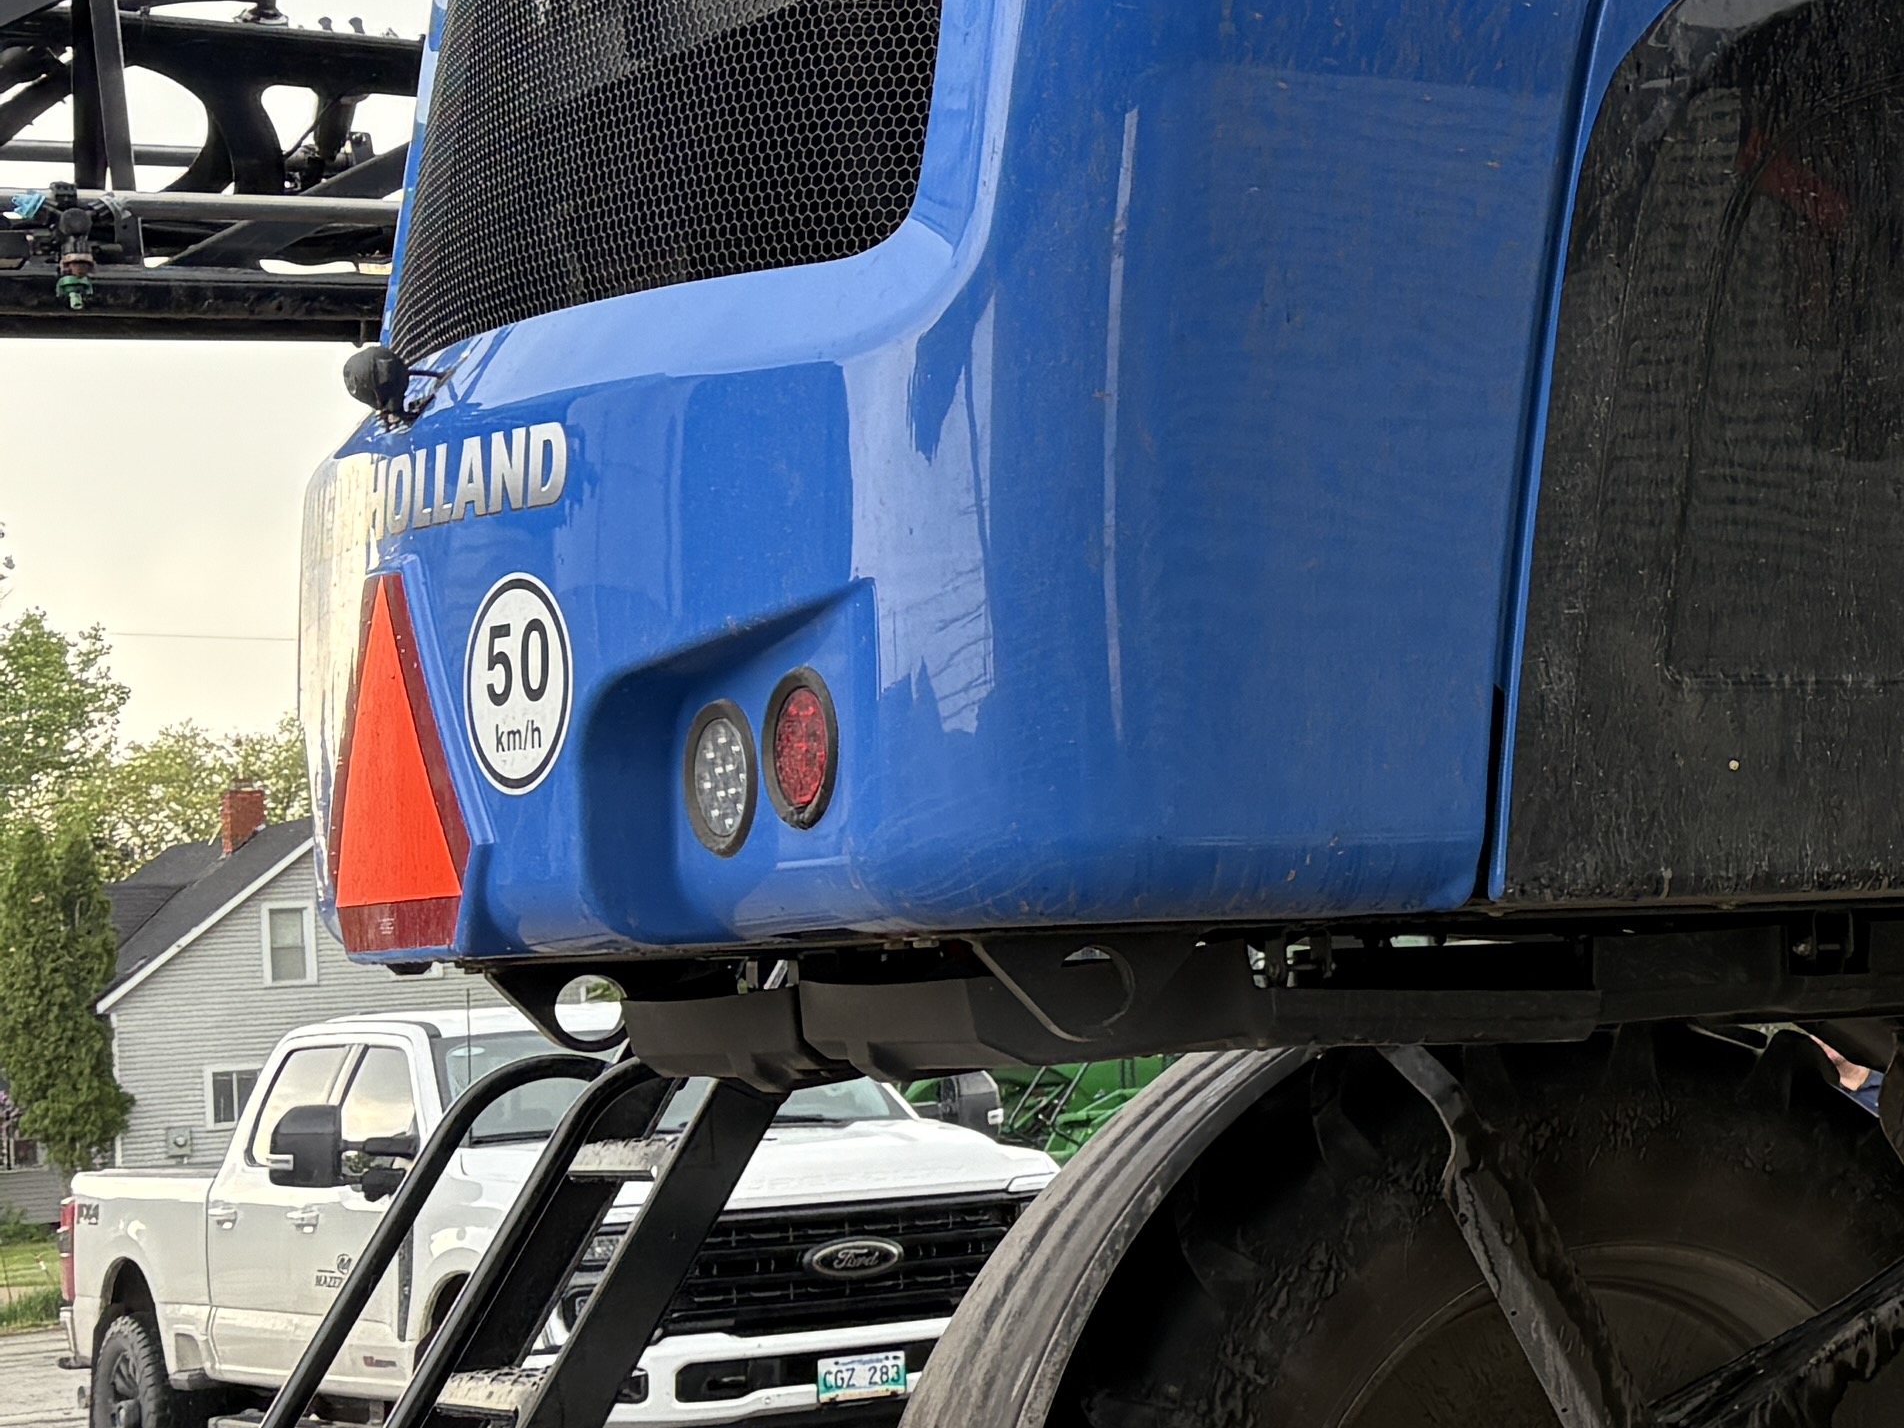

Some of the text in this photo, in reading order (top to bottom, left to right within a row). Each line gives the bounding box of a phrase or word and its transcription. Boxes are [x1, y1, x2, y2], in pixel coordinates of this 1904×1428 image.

[366, 421, 567, 541] HOLLAND
[486, 617, 549, 708] 50
[495, 719, 542, 752] km/h
[832, 1248, 879, 1269] Ford
[823, 1363, 901, 1390] CGZ 283
